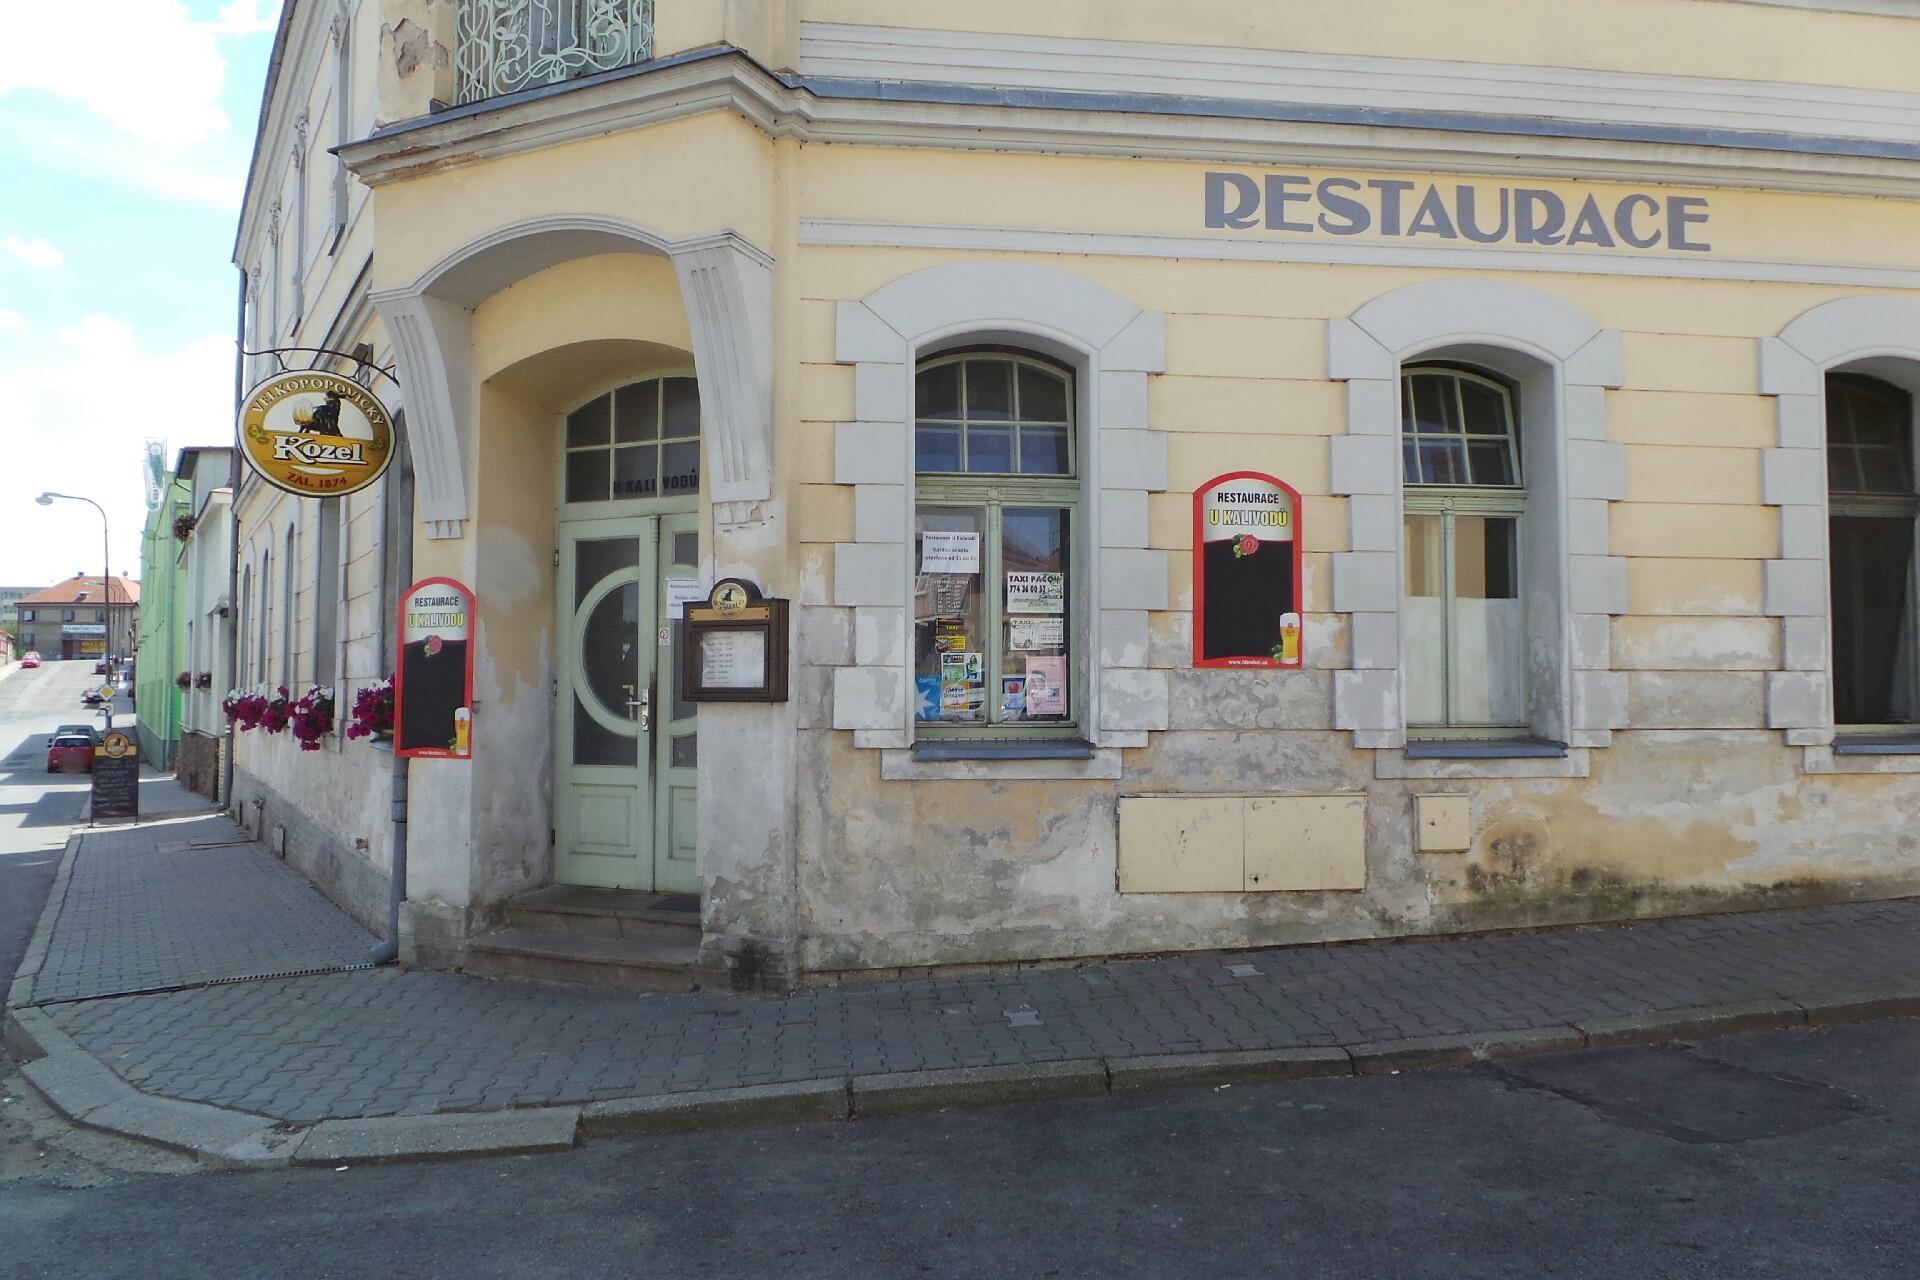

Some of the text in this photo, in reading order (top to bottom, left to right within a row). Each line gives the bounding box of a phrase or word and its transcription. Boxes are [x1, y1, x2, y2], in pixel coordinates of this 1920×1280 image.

[1204, 171, 1711, 252] RESTAURACE
[273, 435, 369, 465] Kozel
[1217, 492, 1279, 504] RESTAURACE
[1209, 507, 1288, 527] U KALIVODŮ
[1009, 575, 1029, 583] TAXI
[414, 596, 460, 607] RESTAURACE
[408, 609, 465, 628] U KALIVODŮ
